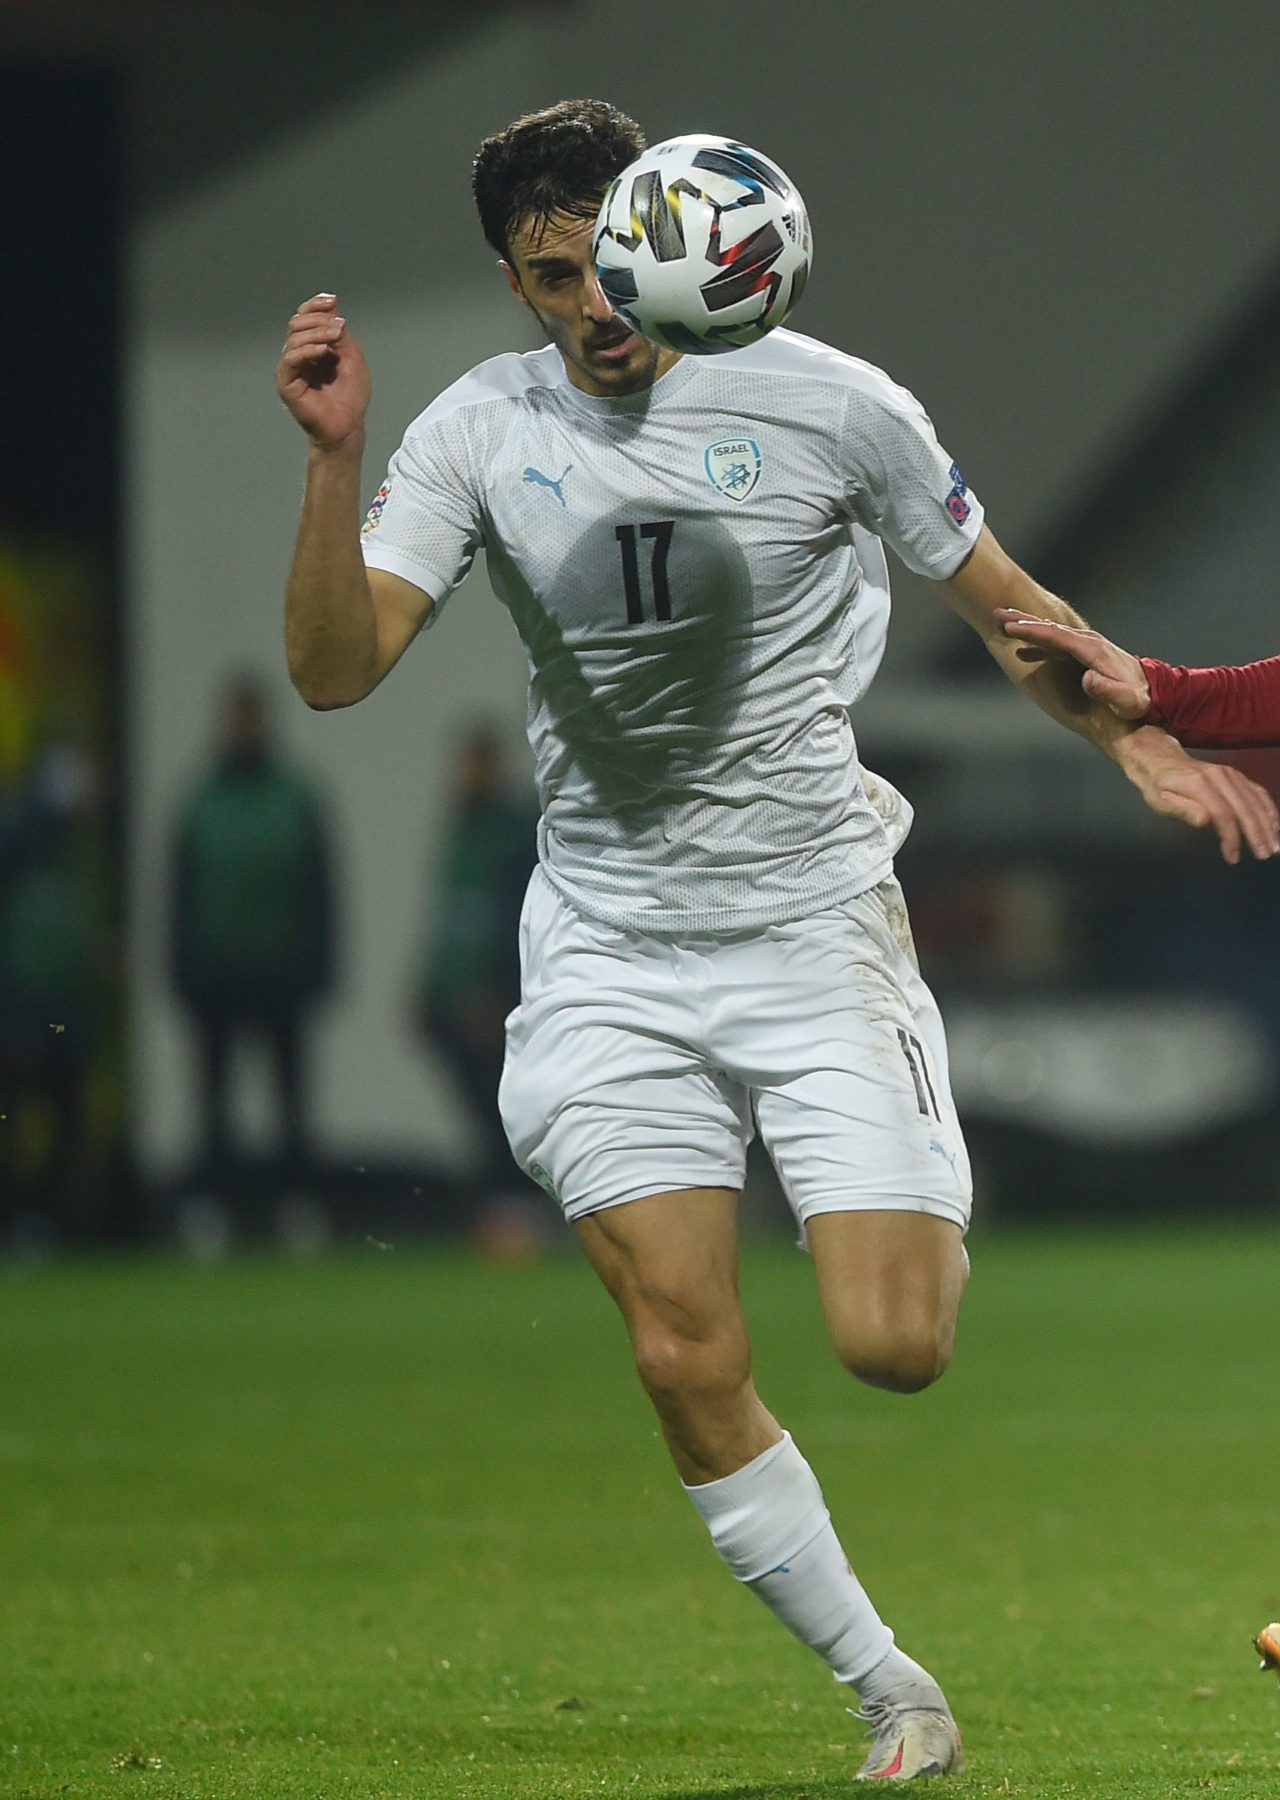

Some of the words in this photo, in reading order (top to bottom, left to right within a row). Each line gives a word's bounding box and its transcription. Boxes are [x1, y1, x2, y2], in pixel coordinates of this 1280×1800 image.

[713, 444, 750, 457] ISRAEL
[615, 521, 675, 624] 17
[896, 1027, 942, 1124] 17
